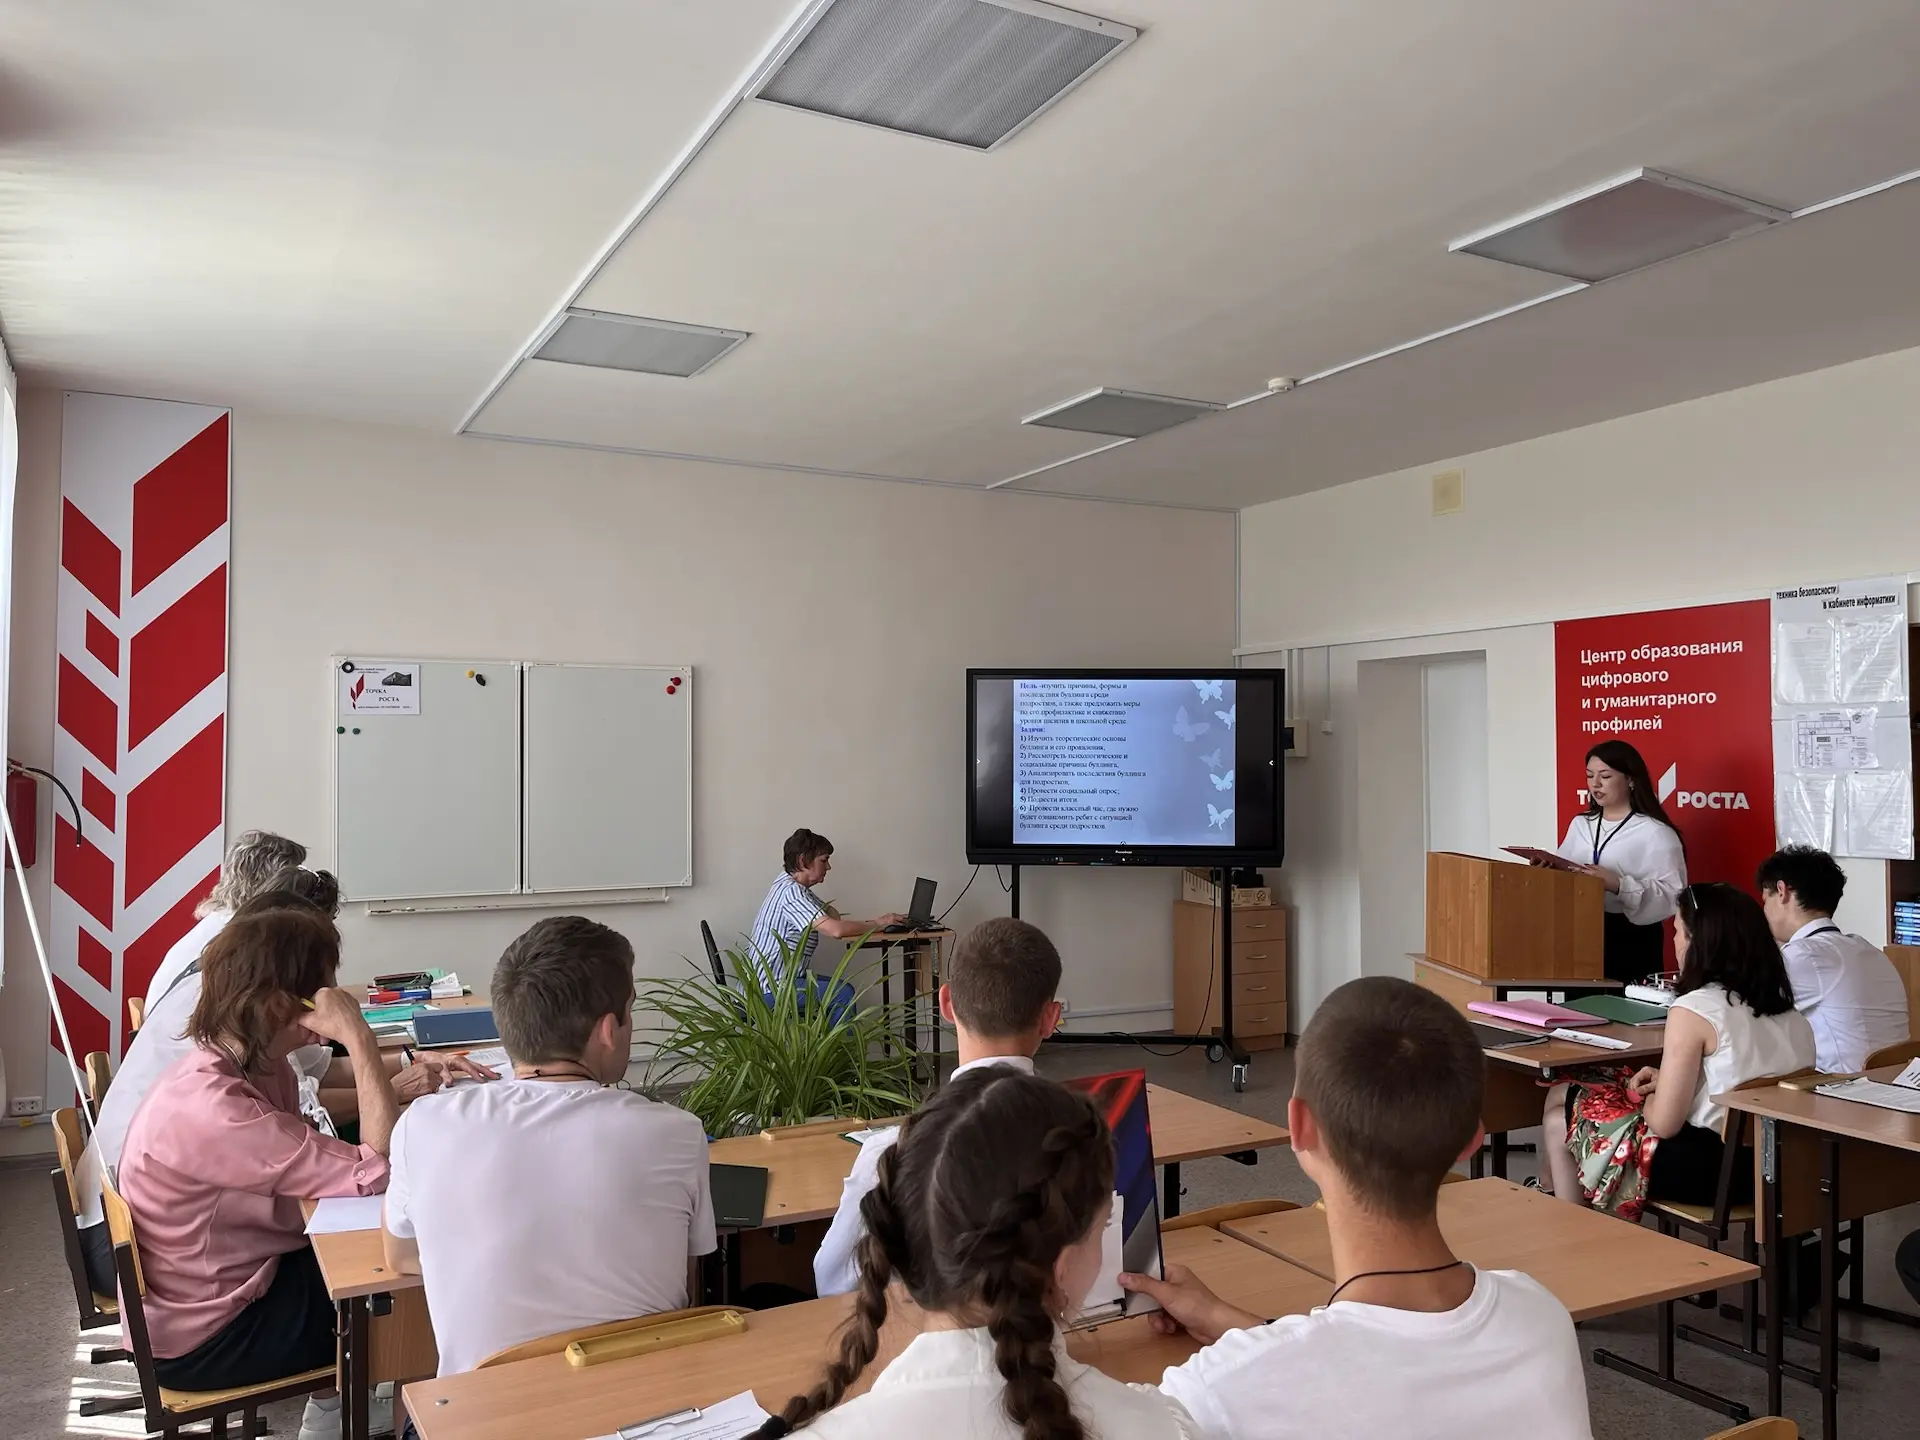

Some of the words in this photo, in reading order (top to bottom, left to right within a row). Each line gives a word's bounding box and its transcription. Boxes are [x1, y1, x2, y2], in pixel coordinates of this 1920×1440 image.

[1776, 590, 1798, 599] техника
[1799, 585, 1837, 598] безопасности
[1828, 597, 1856, 608] кабинете
[1856, 595, 1896, 608] информатики
[1580, 650, 1626, 666] Центр
[1630, 640, 1744, 662] образования
[1581, 670, 1670, 688] цифрового
[1582, 698, 1590, 709] и
[1595, 691, 1717, 711] гуманитарного
[1582, 716, 1663, 734] профилей
[1677, 791, 1750, 810] РОСТА
